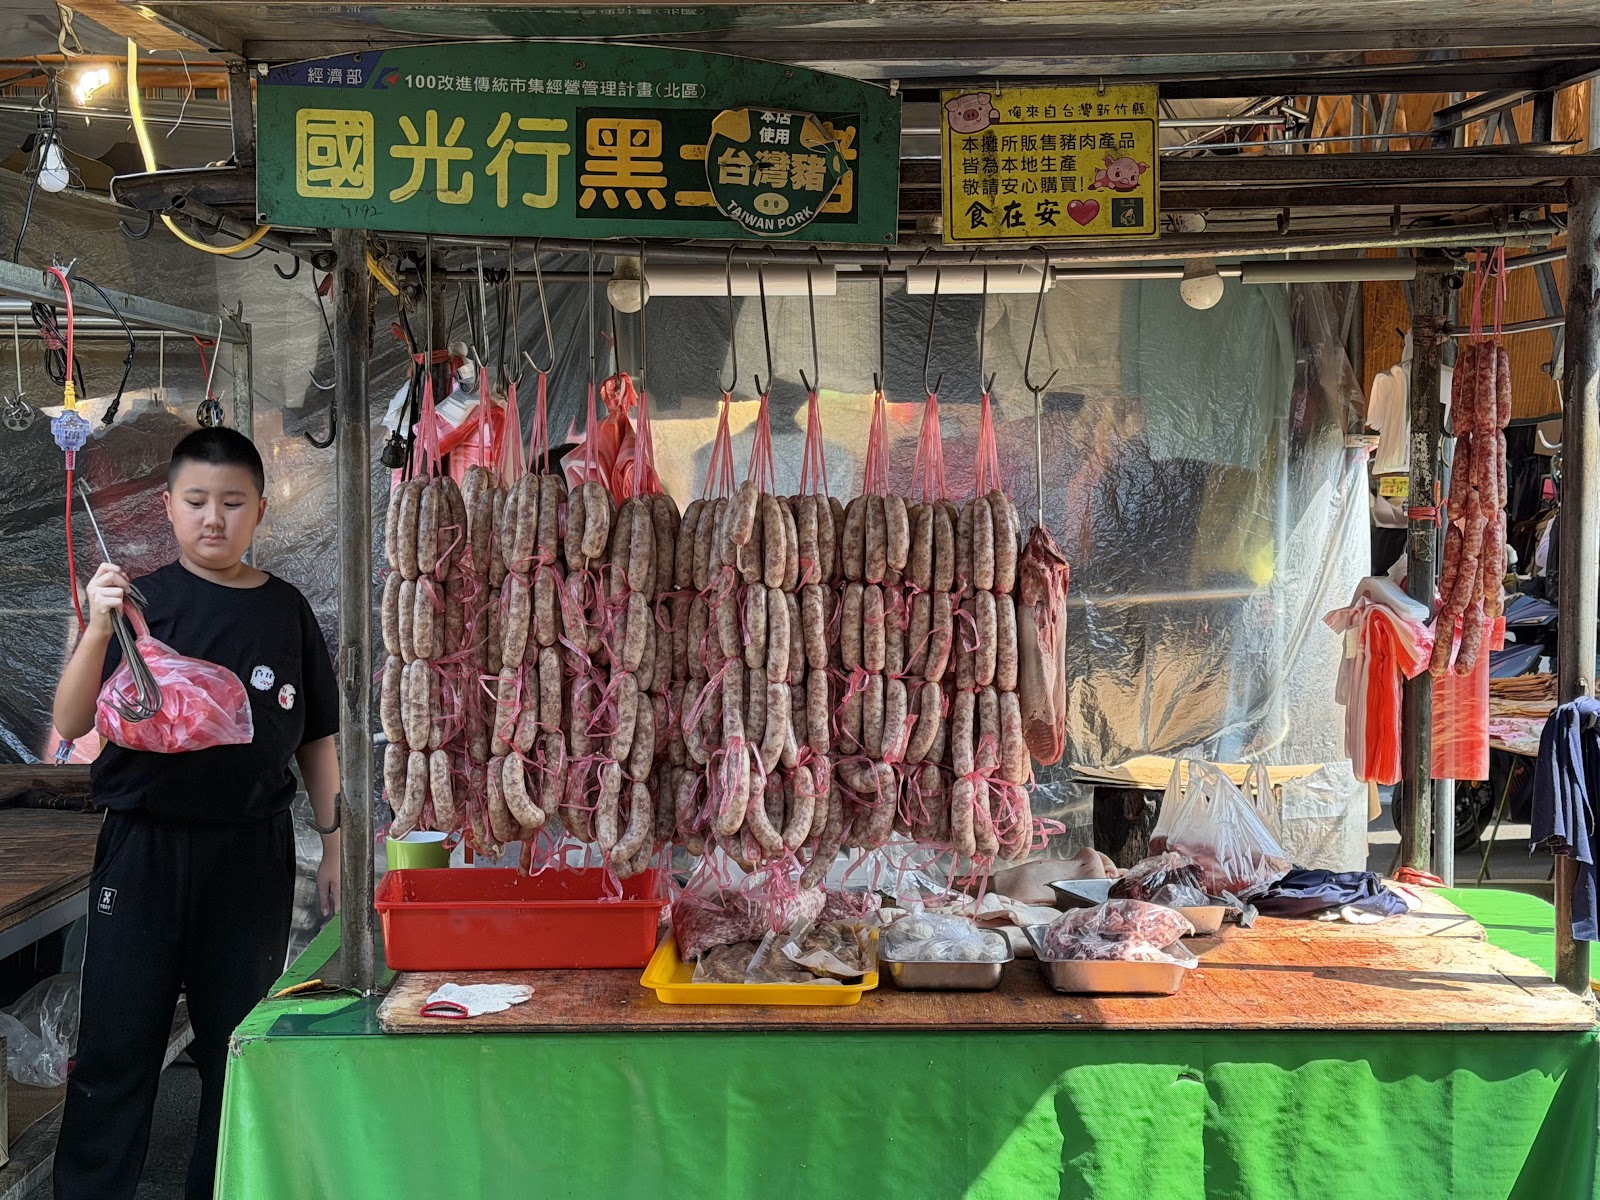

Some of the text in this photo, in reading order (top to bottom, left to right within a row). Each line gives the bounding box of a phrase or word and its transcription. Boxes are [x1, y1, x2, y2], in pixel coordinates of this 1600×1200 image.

[307, 67, 363, 86] 經濟部
[760, 112, 792, 125] 本店
[1007, 102, 1147, 118] 俺來自台灣新竹縣
[759, 127, 790, 145] 使用
[961, 132, 1135, 153] 本攤所販售豬肉產品
[717, 147, 827, 192] 台灣豬
[962, 154, 1077, 175] 皆為本地生產
[962, 176, 1085, 196] 敬請安心購買!
[726, 200, 815, 230] TAIWAN PORK
[964, 198, 1061, 229] 食在安
